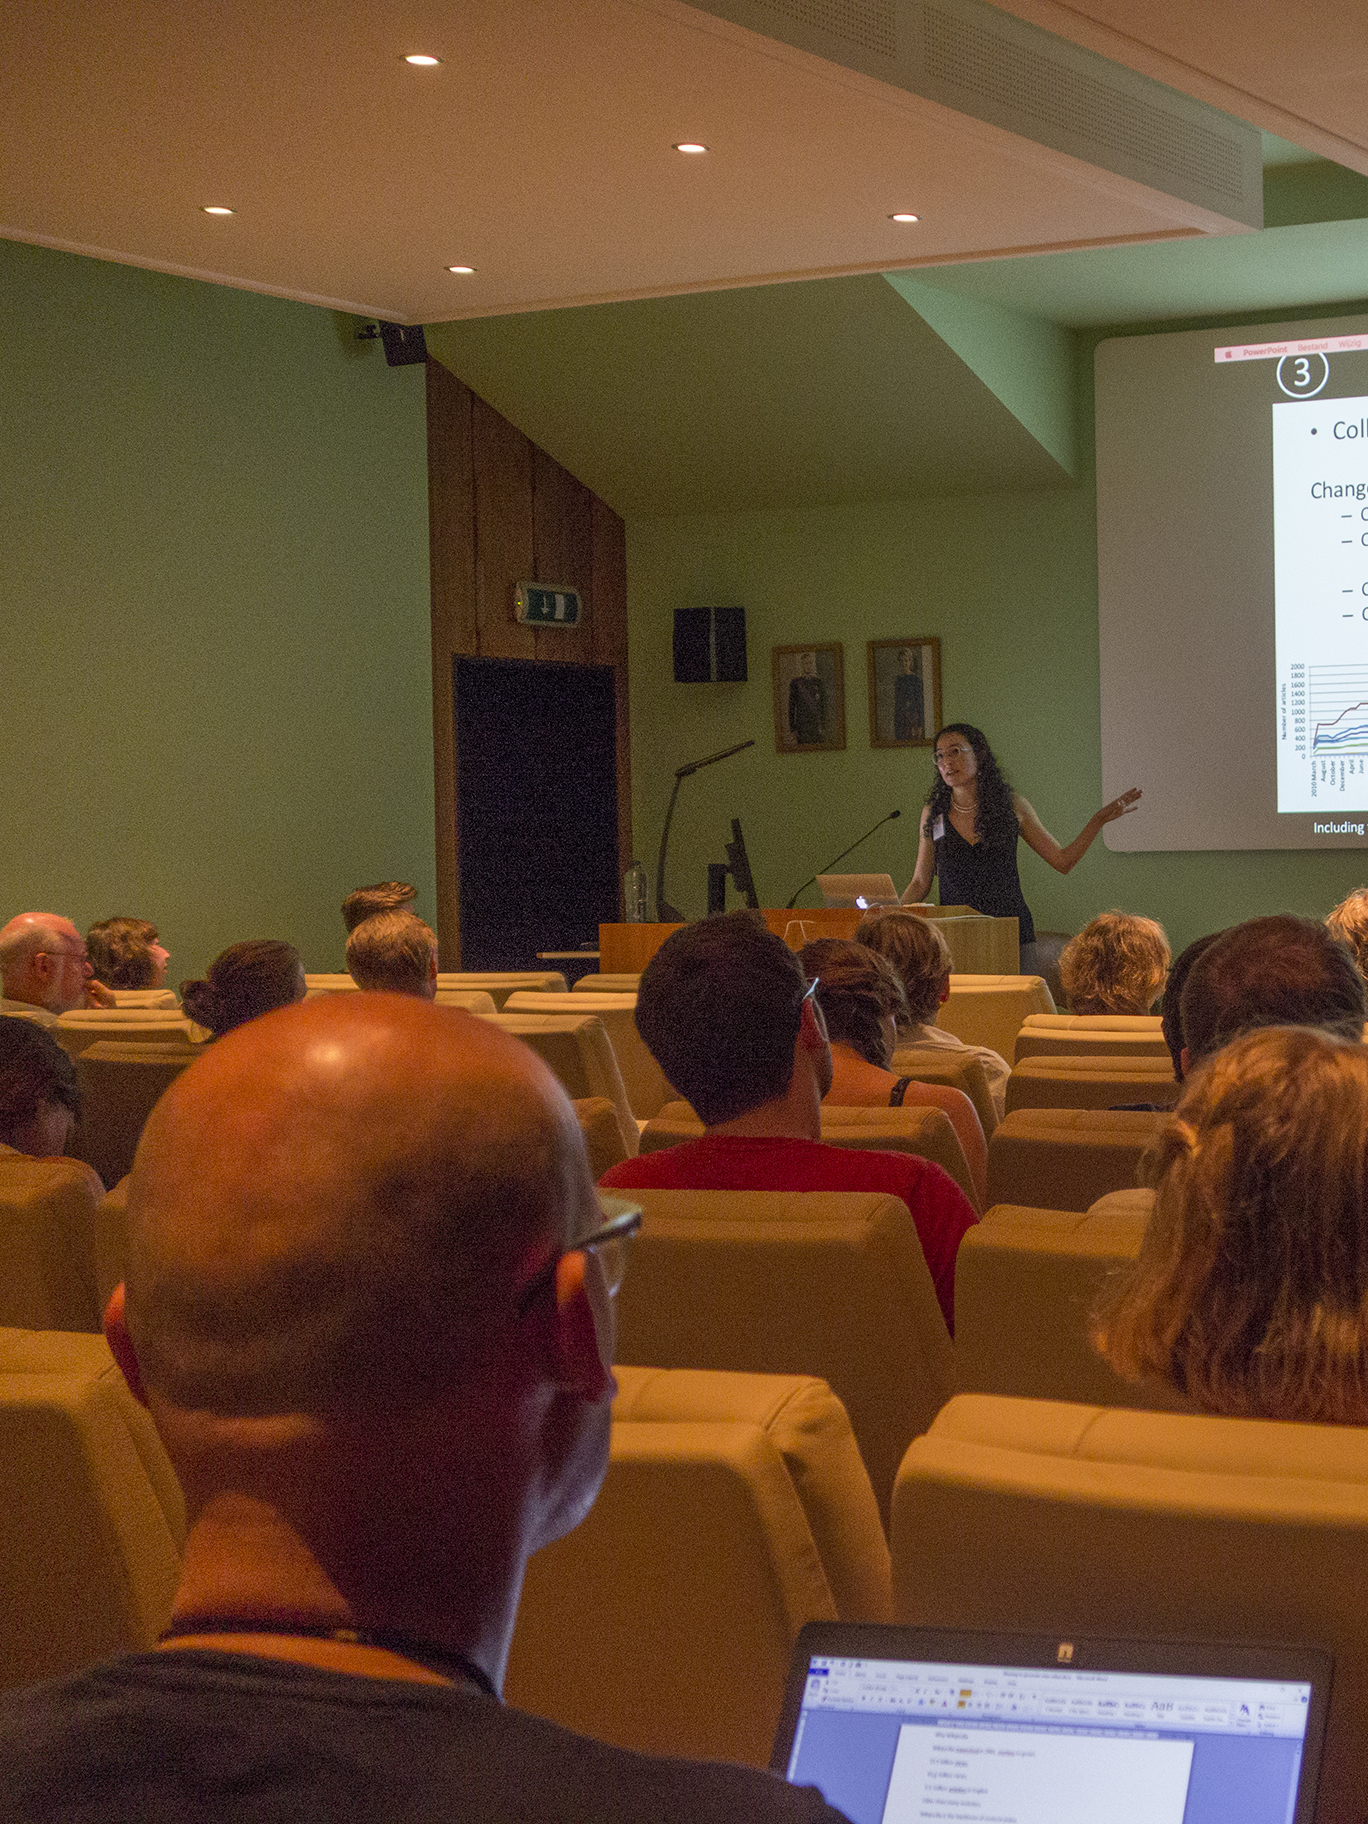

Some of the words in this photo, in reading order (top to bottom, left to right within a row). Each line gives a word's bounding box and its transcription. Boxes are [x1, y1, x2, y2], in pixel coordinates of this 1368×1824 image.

[1244, 344, 1288, 357] PowerPoint
[1298, 342, 1328, 352] Bestand
[1338, 338, 1361, 350] Wijzig
[1294, 358, 1310, 386] 3
[1314, 822, 1364, 835] Including
